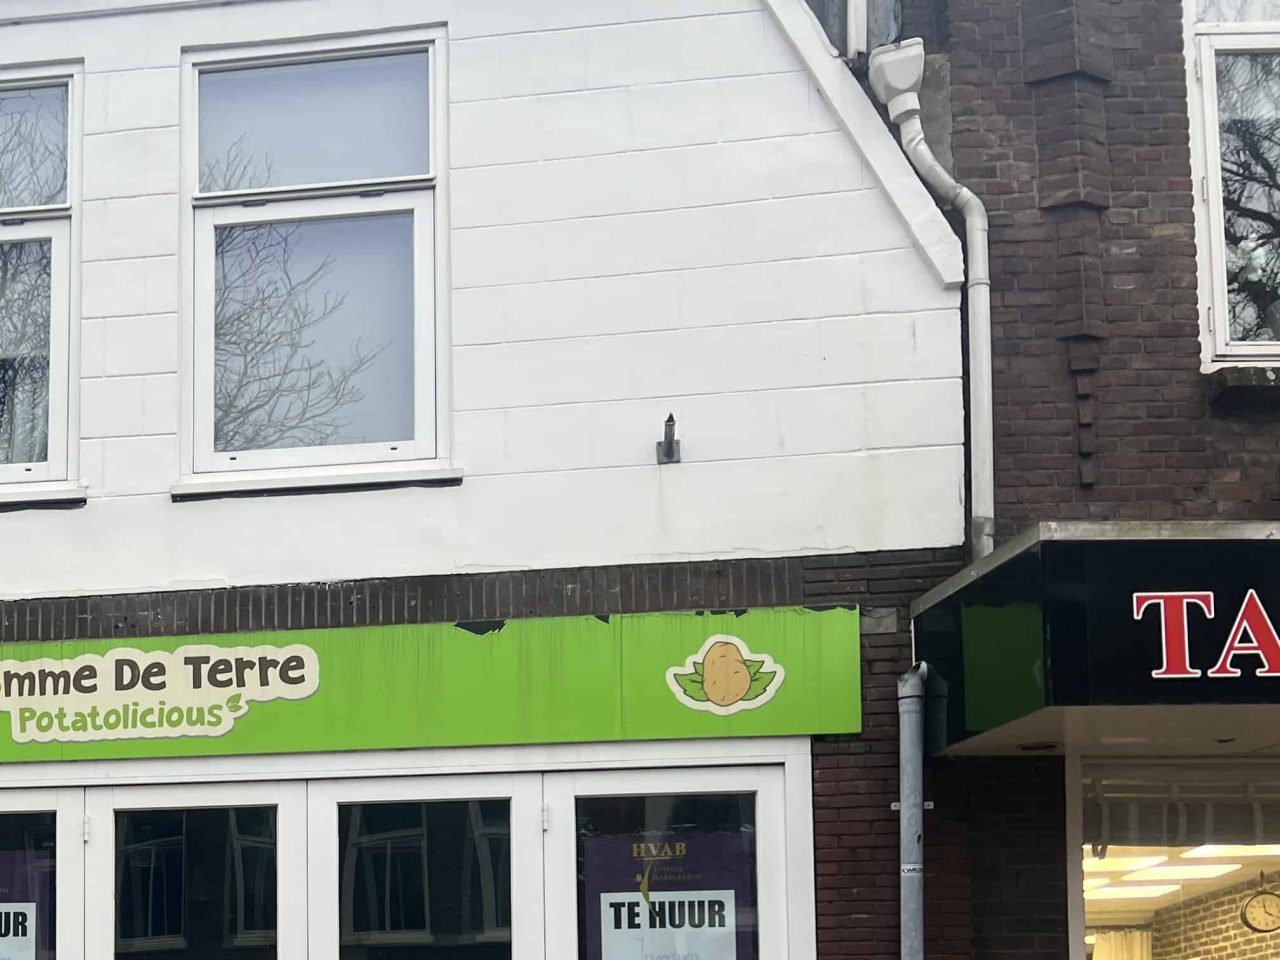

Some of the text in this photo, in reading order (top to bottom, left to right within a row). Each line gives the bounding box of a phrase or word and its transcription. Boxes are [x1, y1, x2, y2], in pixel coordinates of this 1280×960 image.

[1133, 588, 1280, 678] TA
[114, 658, 166, 691] De
[184, 655, 305, 689] Terre
[19, 701, 223, 734] Potatolicious
[632, 842, 687, 857] HVAB
[609, 900, 726, 929] TE HUUR
